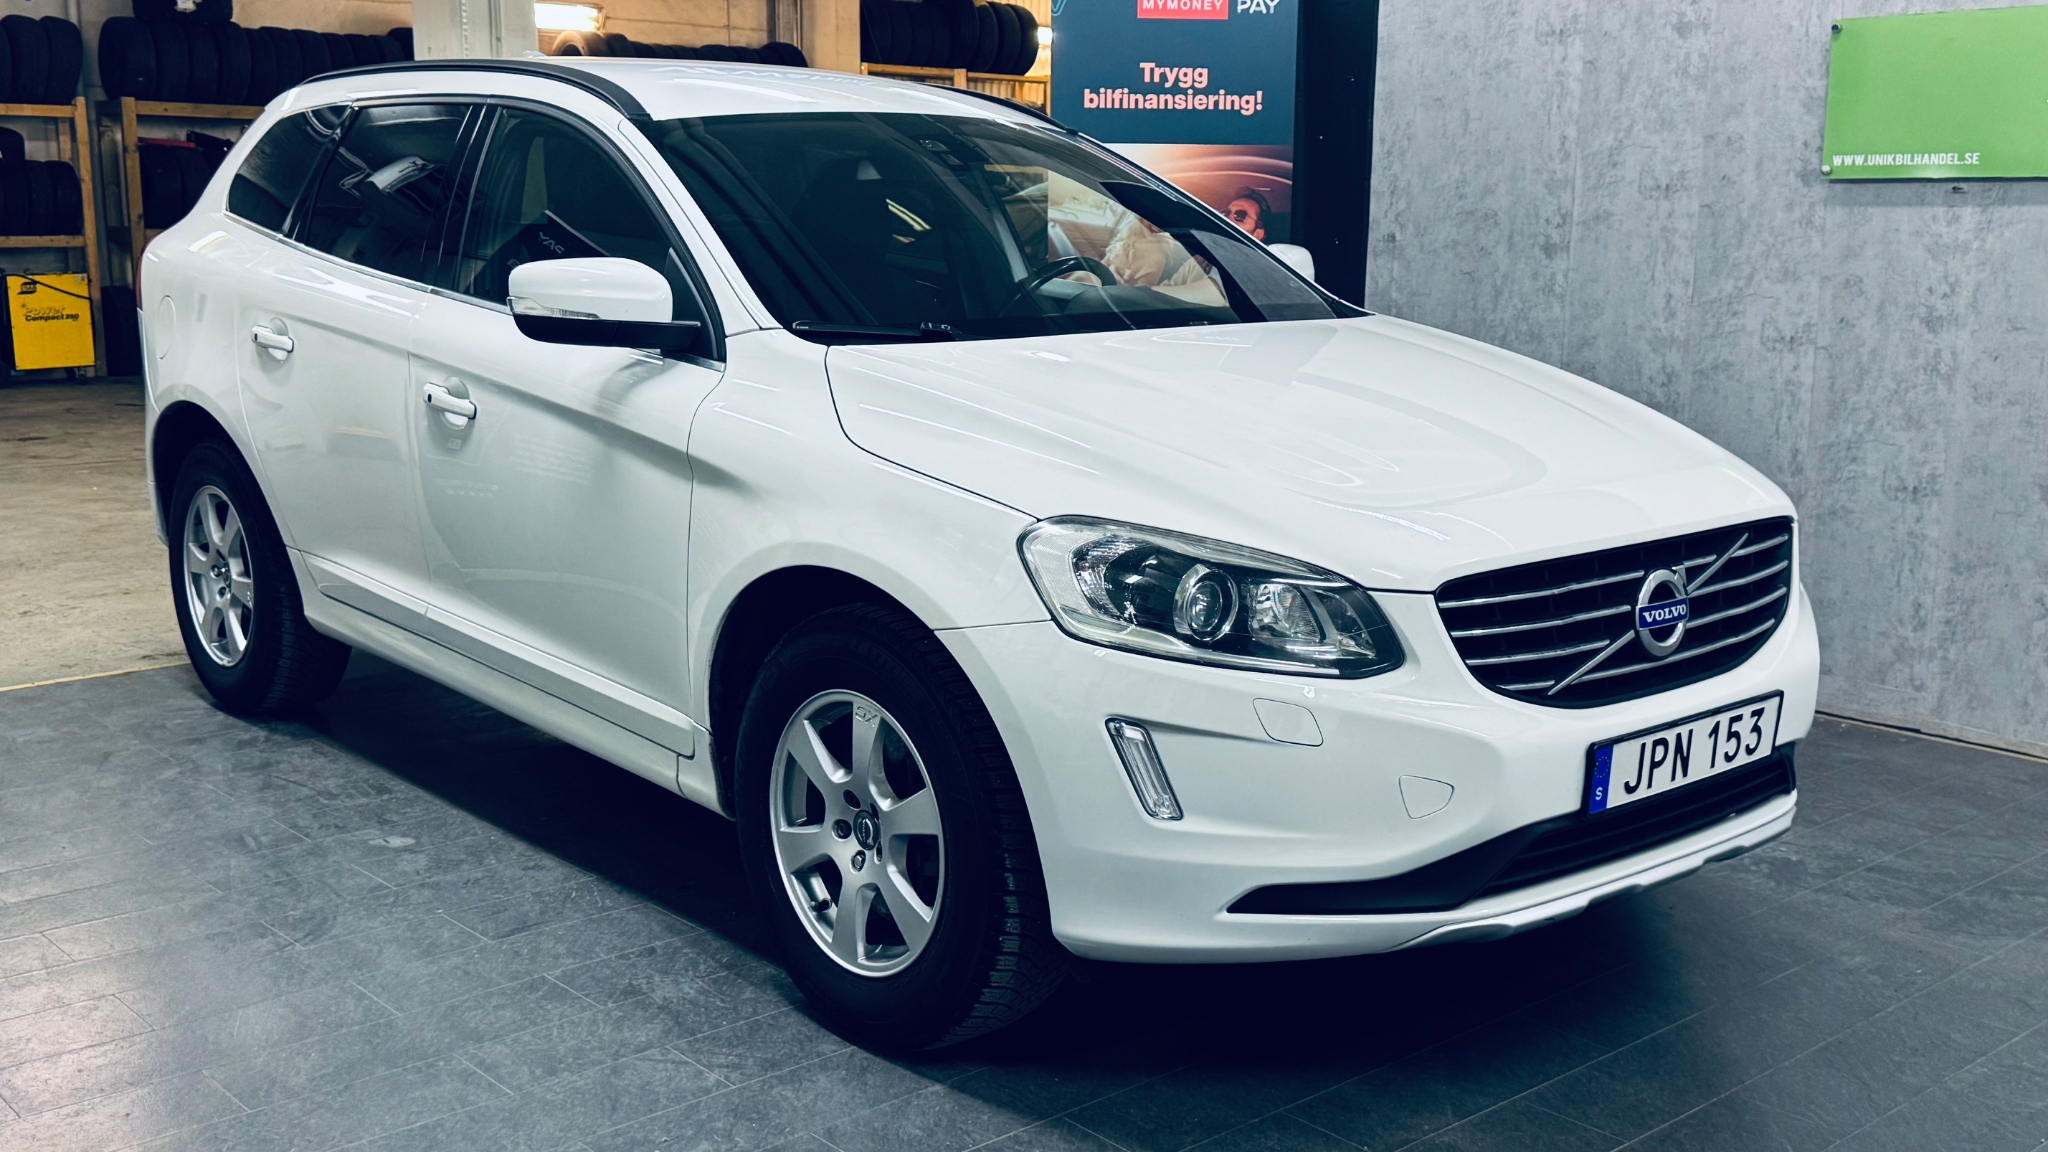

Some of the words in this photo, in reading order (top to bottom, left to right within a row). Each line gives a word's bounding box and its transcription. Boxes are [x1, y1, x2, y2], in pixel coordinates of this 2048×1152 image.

[1142, 0, 1223, 10] MYMONEY
[1237, 0, 1280, 14] PAY
[1139, 62, 1209, 88] Trygg
[1083, 87, 1263, 116] bilfinansiering!
[1832, 152, 1981, 167] WWW.UNIKBILHANDEL.SE
[25, 313, 64, 322] Compact
[1642, 604, 1687, 623] VOLVO
[1623, 728, 1694, 795] JPN
[1708, 706, 1766, 769] 153
[1595, 786, 1603, 801] S
